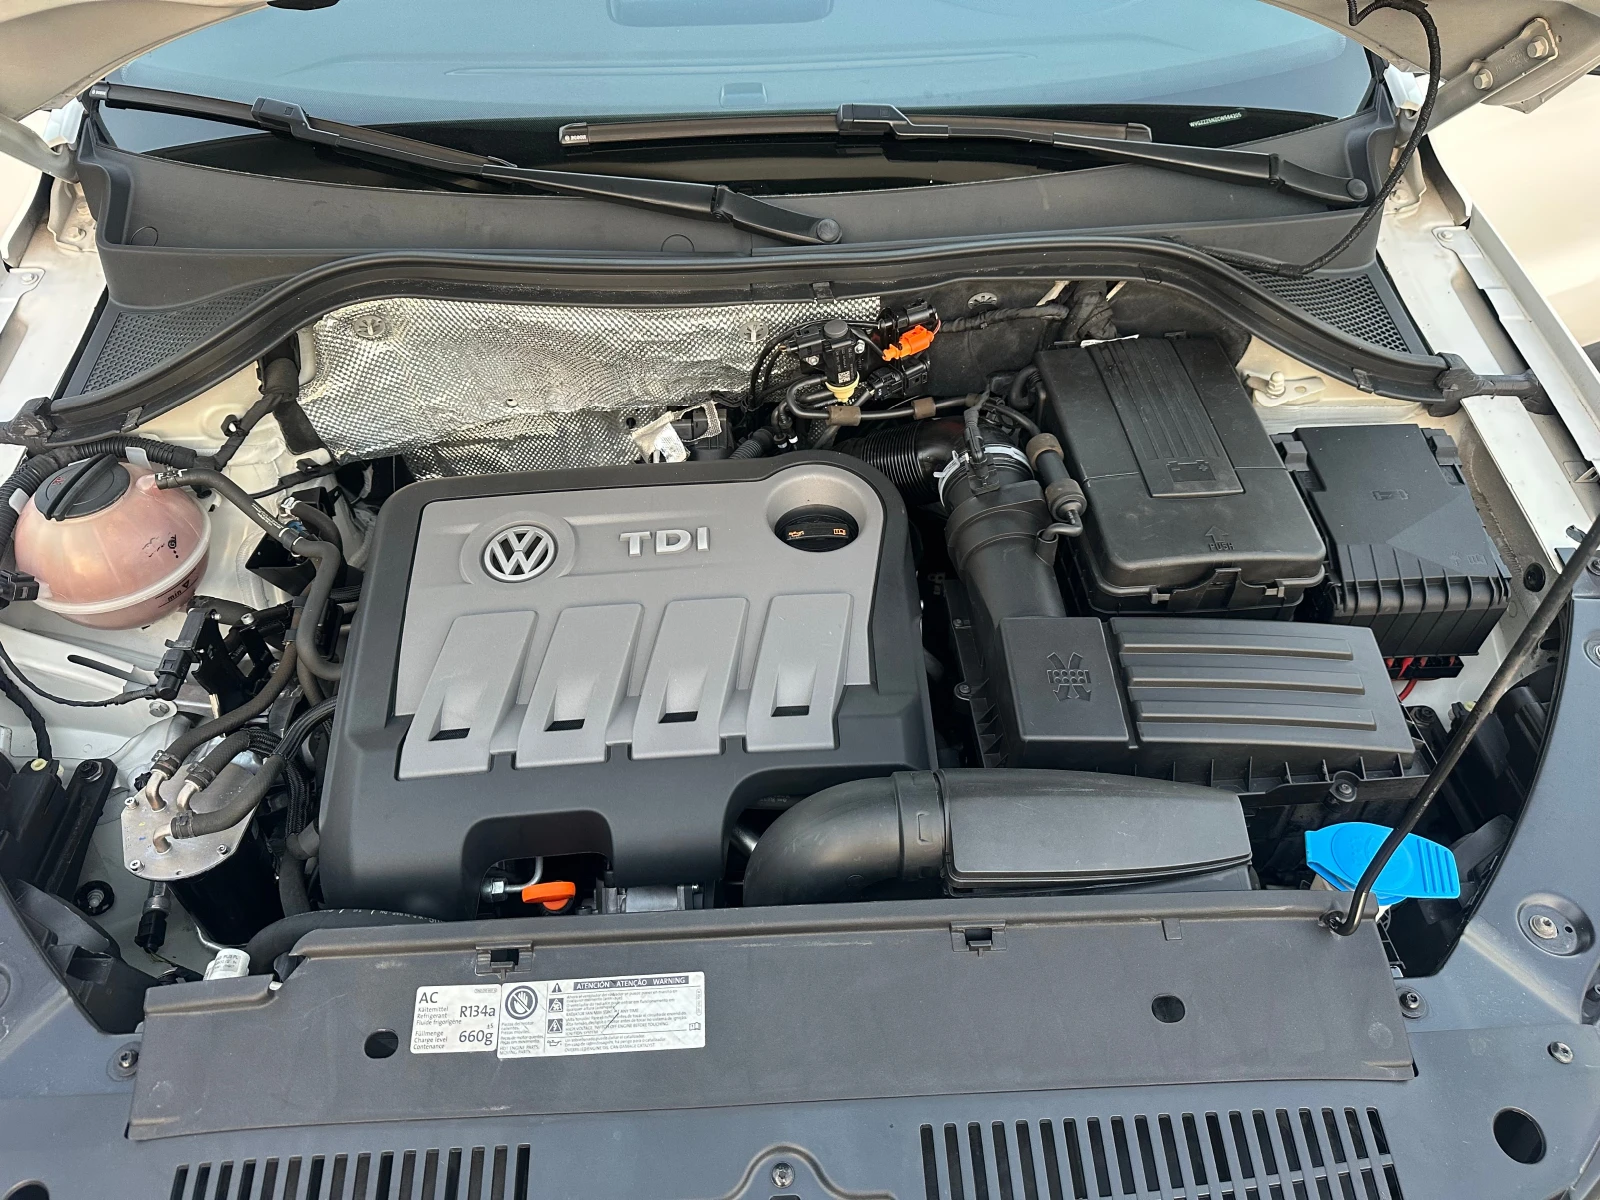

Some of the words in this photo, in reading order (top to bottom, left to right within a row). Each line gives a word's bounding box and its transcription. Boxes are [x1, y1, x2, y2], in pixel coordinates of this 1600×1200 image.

[619, 526, 710, 557] TDI
[1208, 542, 1235, 551] PUSH
[167, 589, 182, 603] min
[576, 980, 610, 990] ATENCIÓN
[616, 978, 648, 987] ATENÇÃO
[652, 976, 686, 985] WARNING
[419, 991, 439, 1004] AC
[460, 1004, 496, 1018] R134a
[459, 1030, 494, 1046] 660g
